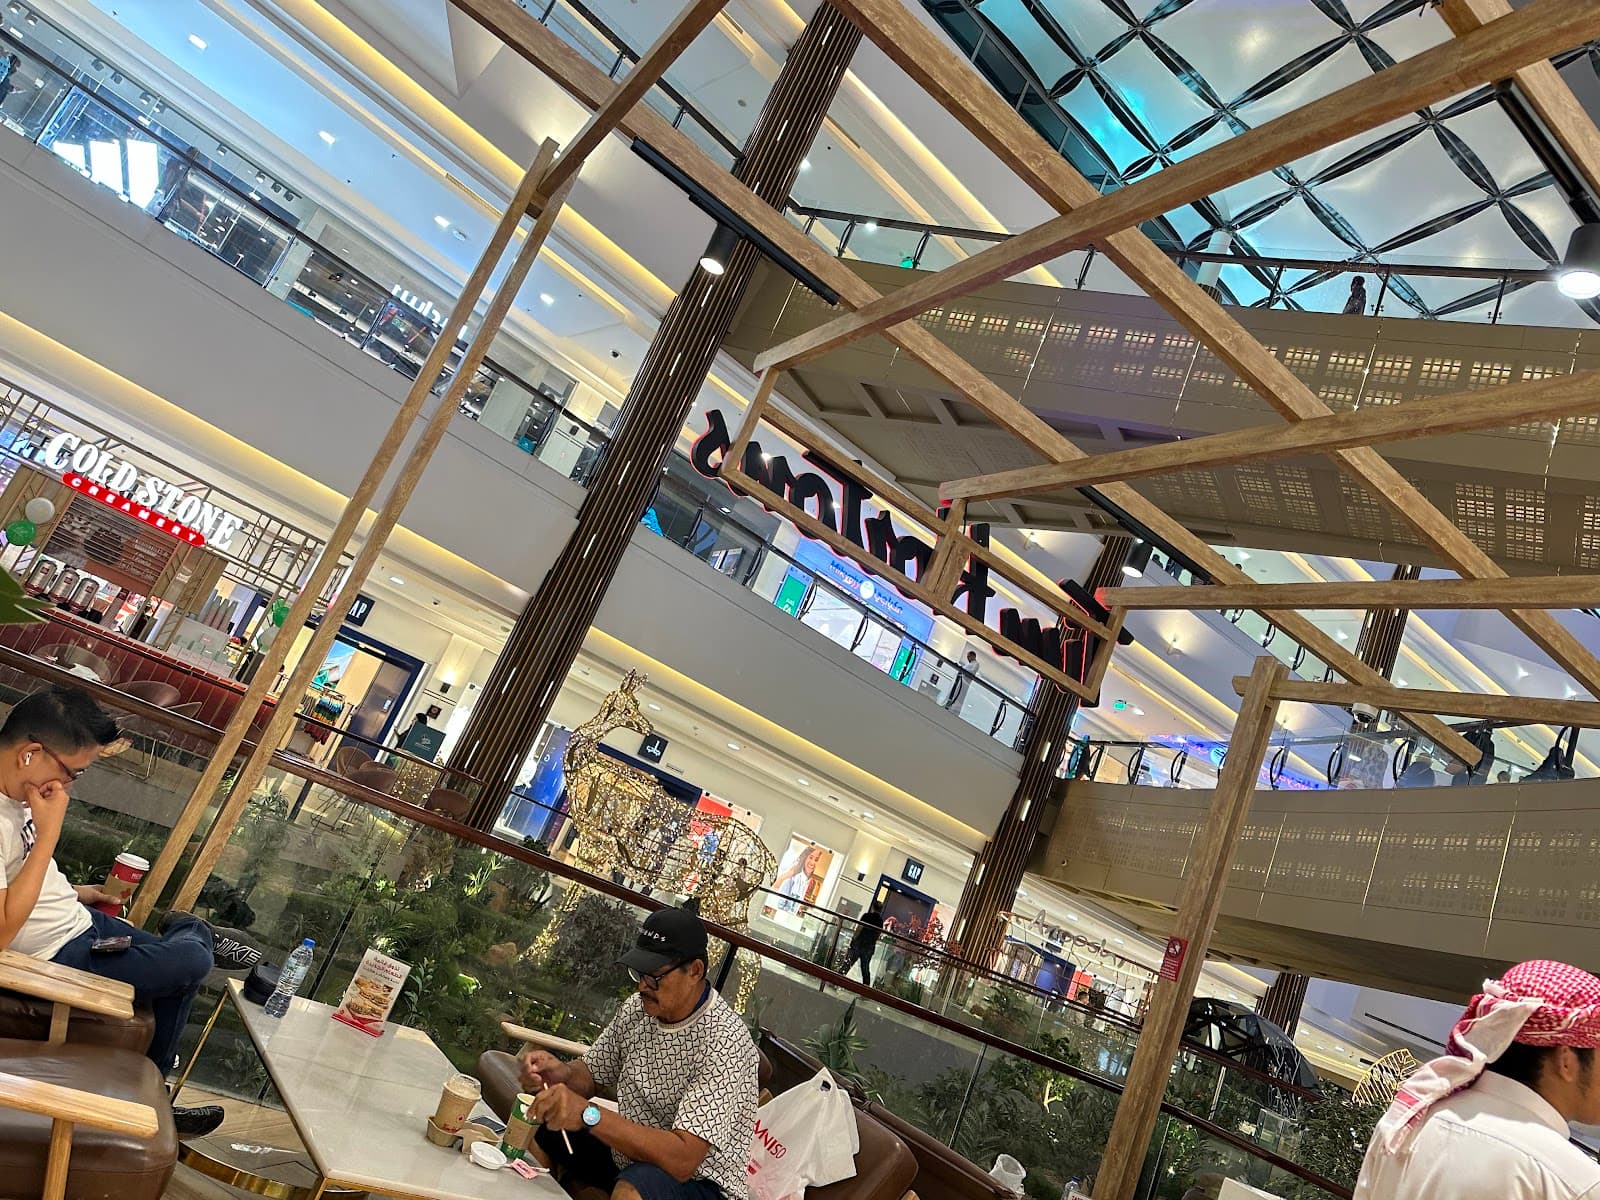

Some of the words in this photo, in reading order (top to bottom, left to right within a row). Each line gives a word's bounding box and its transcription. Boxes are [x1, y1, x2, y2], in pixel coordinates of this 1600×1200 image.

[45, 432, 137, 503] COLD
[137, 474, 244, 551] STONE
[71, 476, 198, 544] CREAMERY
[348, 600, 368, 618] AP
[907, 864, 921, 880] GAP
[753, 1119, 787, 1159] MNISO
